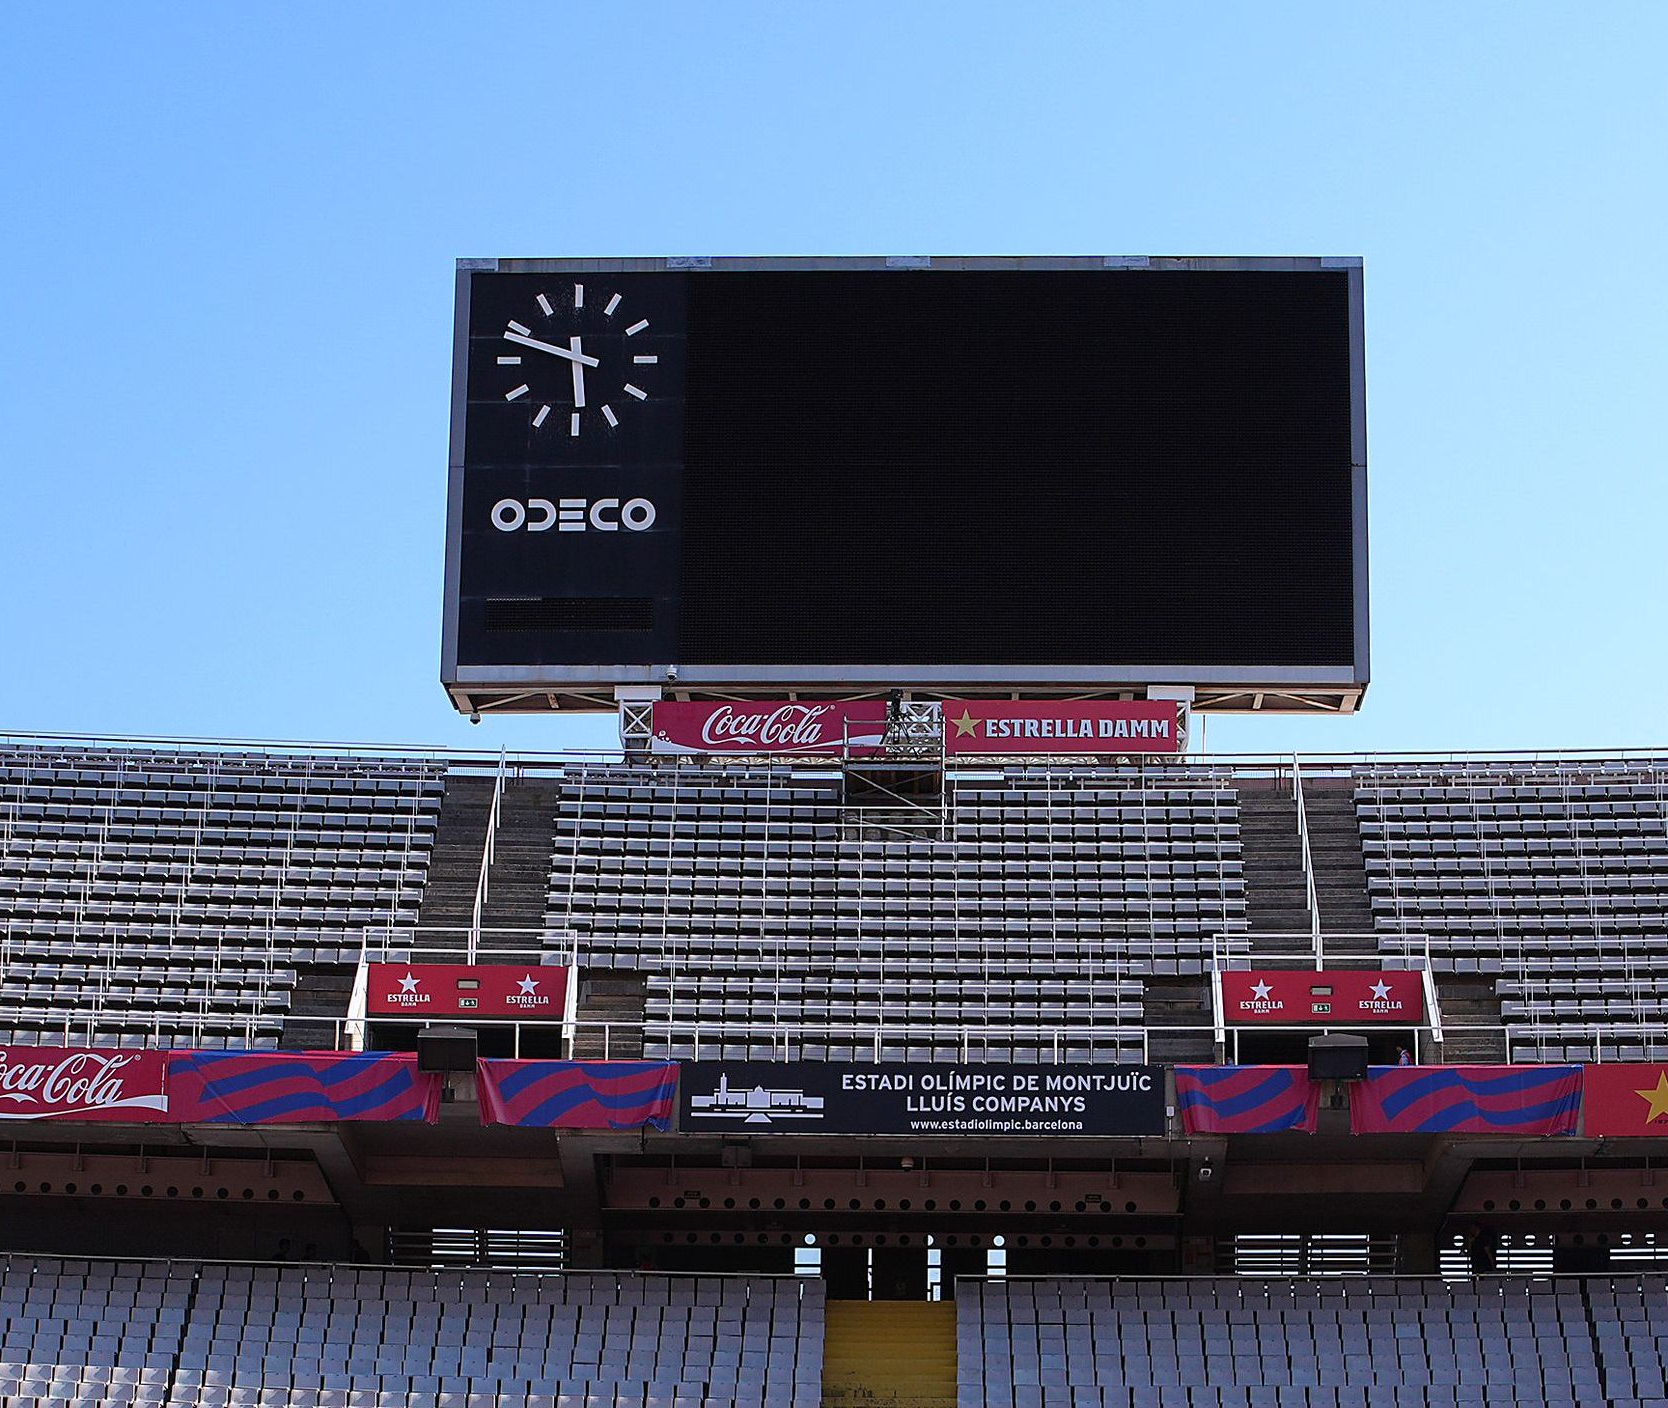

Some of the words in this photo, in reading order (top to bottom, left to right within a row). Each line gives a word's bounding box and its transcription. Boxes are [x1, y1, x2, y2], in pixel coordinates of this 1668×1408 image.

[491, 498, 656, 531] ODECO
[702, 705, 829, 744] Coca-Cola
[985, 719, 1094, 738] ESTRELLA
[1098, 719, 1169, 738] DAMM
[387, 994, 431, 1003] ESTRELLA
[506, 995, 549, 1004] ESTRELLA
[1240, 1001, 1283, 1010] ESTRELLA
[1359, 1001, 1402, 1010] ESTRELLA
[842, 1074, 913, 1091] ESTADI
[920, 1071, 1005, 1091] OLÍMPIC
[1012, 1075, 1040, 1091] DE
[1046, 1071, 1152, 1091] MONTJUÏC
[906, 1093, 965, 1112] LLUÍS
[972, 1096, 1086, 1113] COMPANYS
[910, 1118, 1083, 1132] www.estadiolimpic.barcelona
